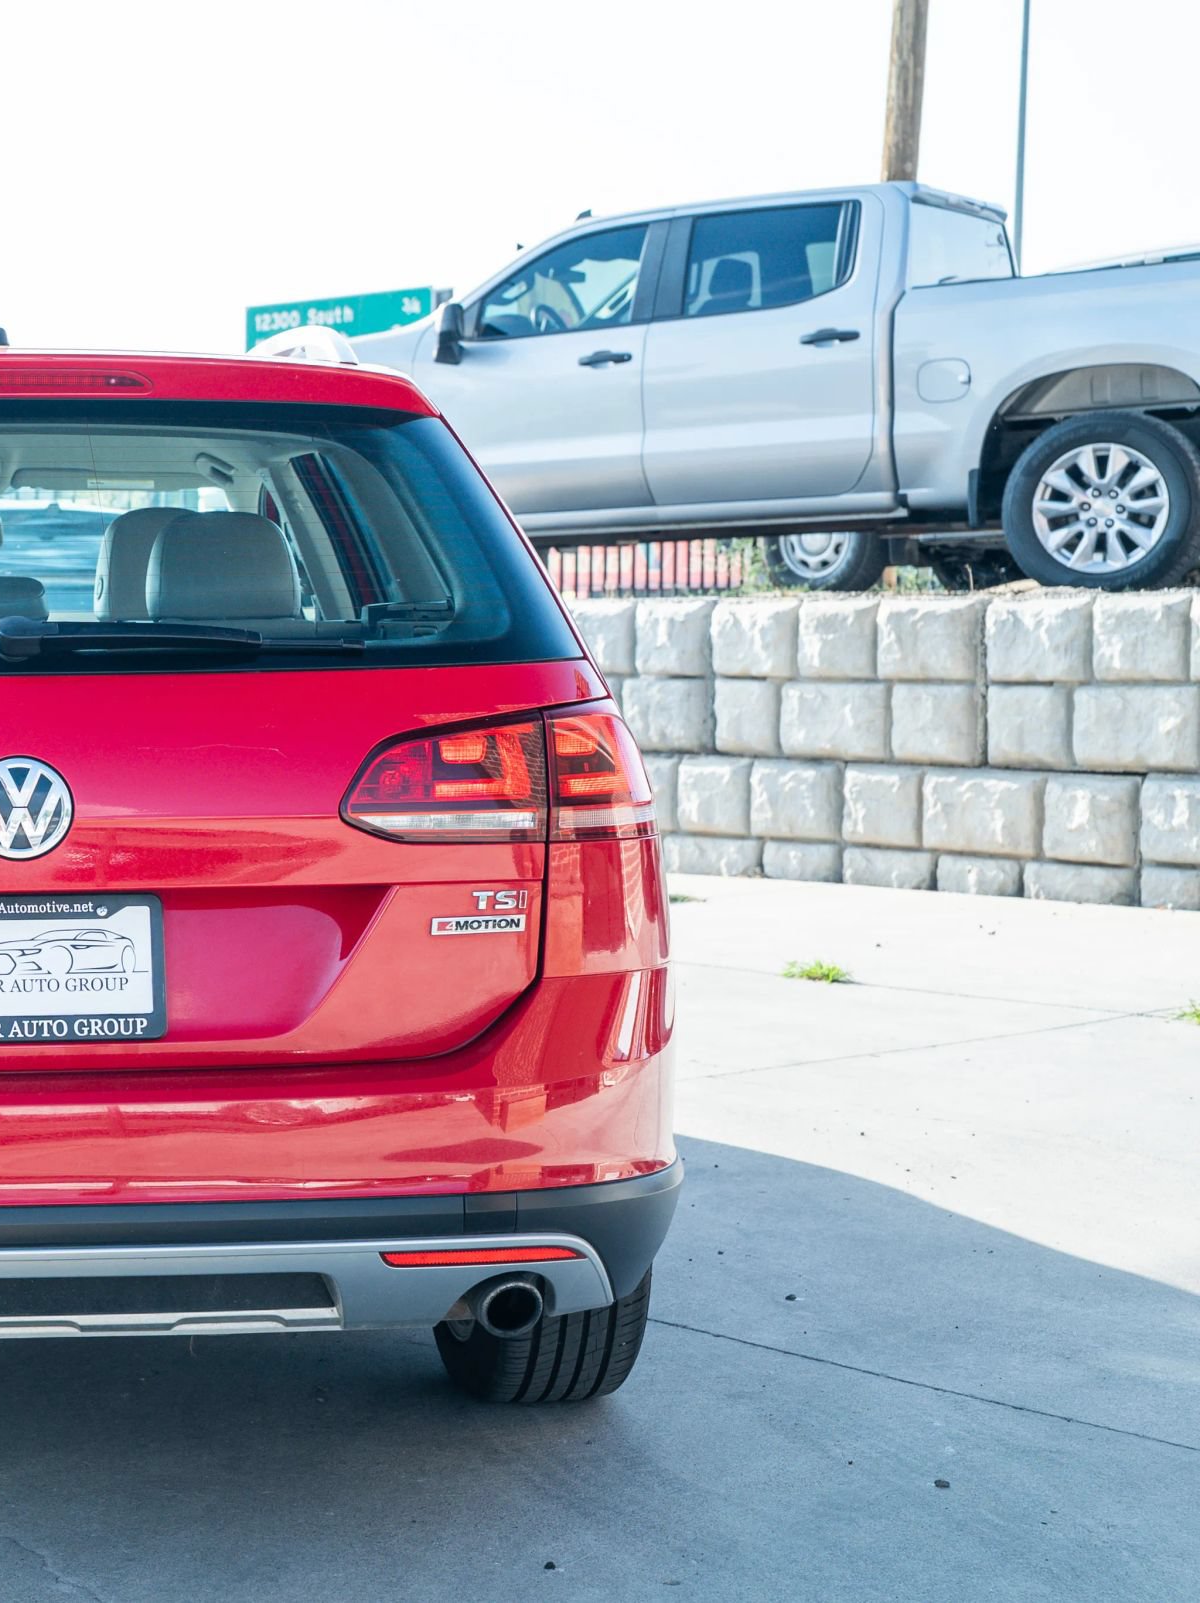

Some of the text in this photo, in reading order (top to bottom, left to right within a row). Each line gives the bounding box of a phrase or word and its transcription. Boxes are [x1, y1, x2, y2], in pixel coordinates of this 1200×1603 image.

[254, 310, 300, 331] 12300
[306, 305, 354, 326] South
[472, 889, 528, 910] TSI
[10, 978, 60, 993] AUTO
[65, 977, 129, 992] GROUP
[8, 1019, 68, 1039] AUTO
[73, 1017, 149, 1037] GROUP
